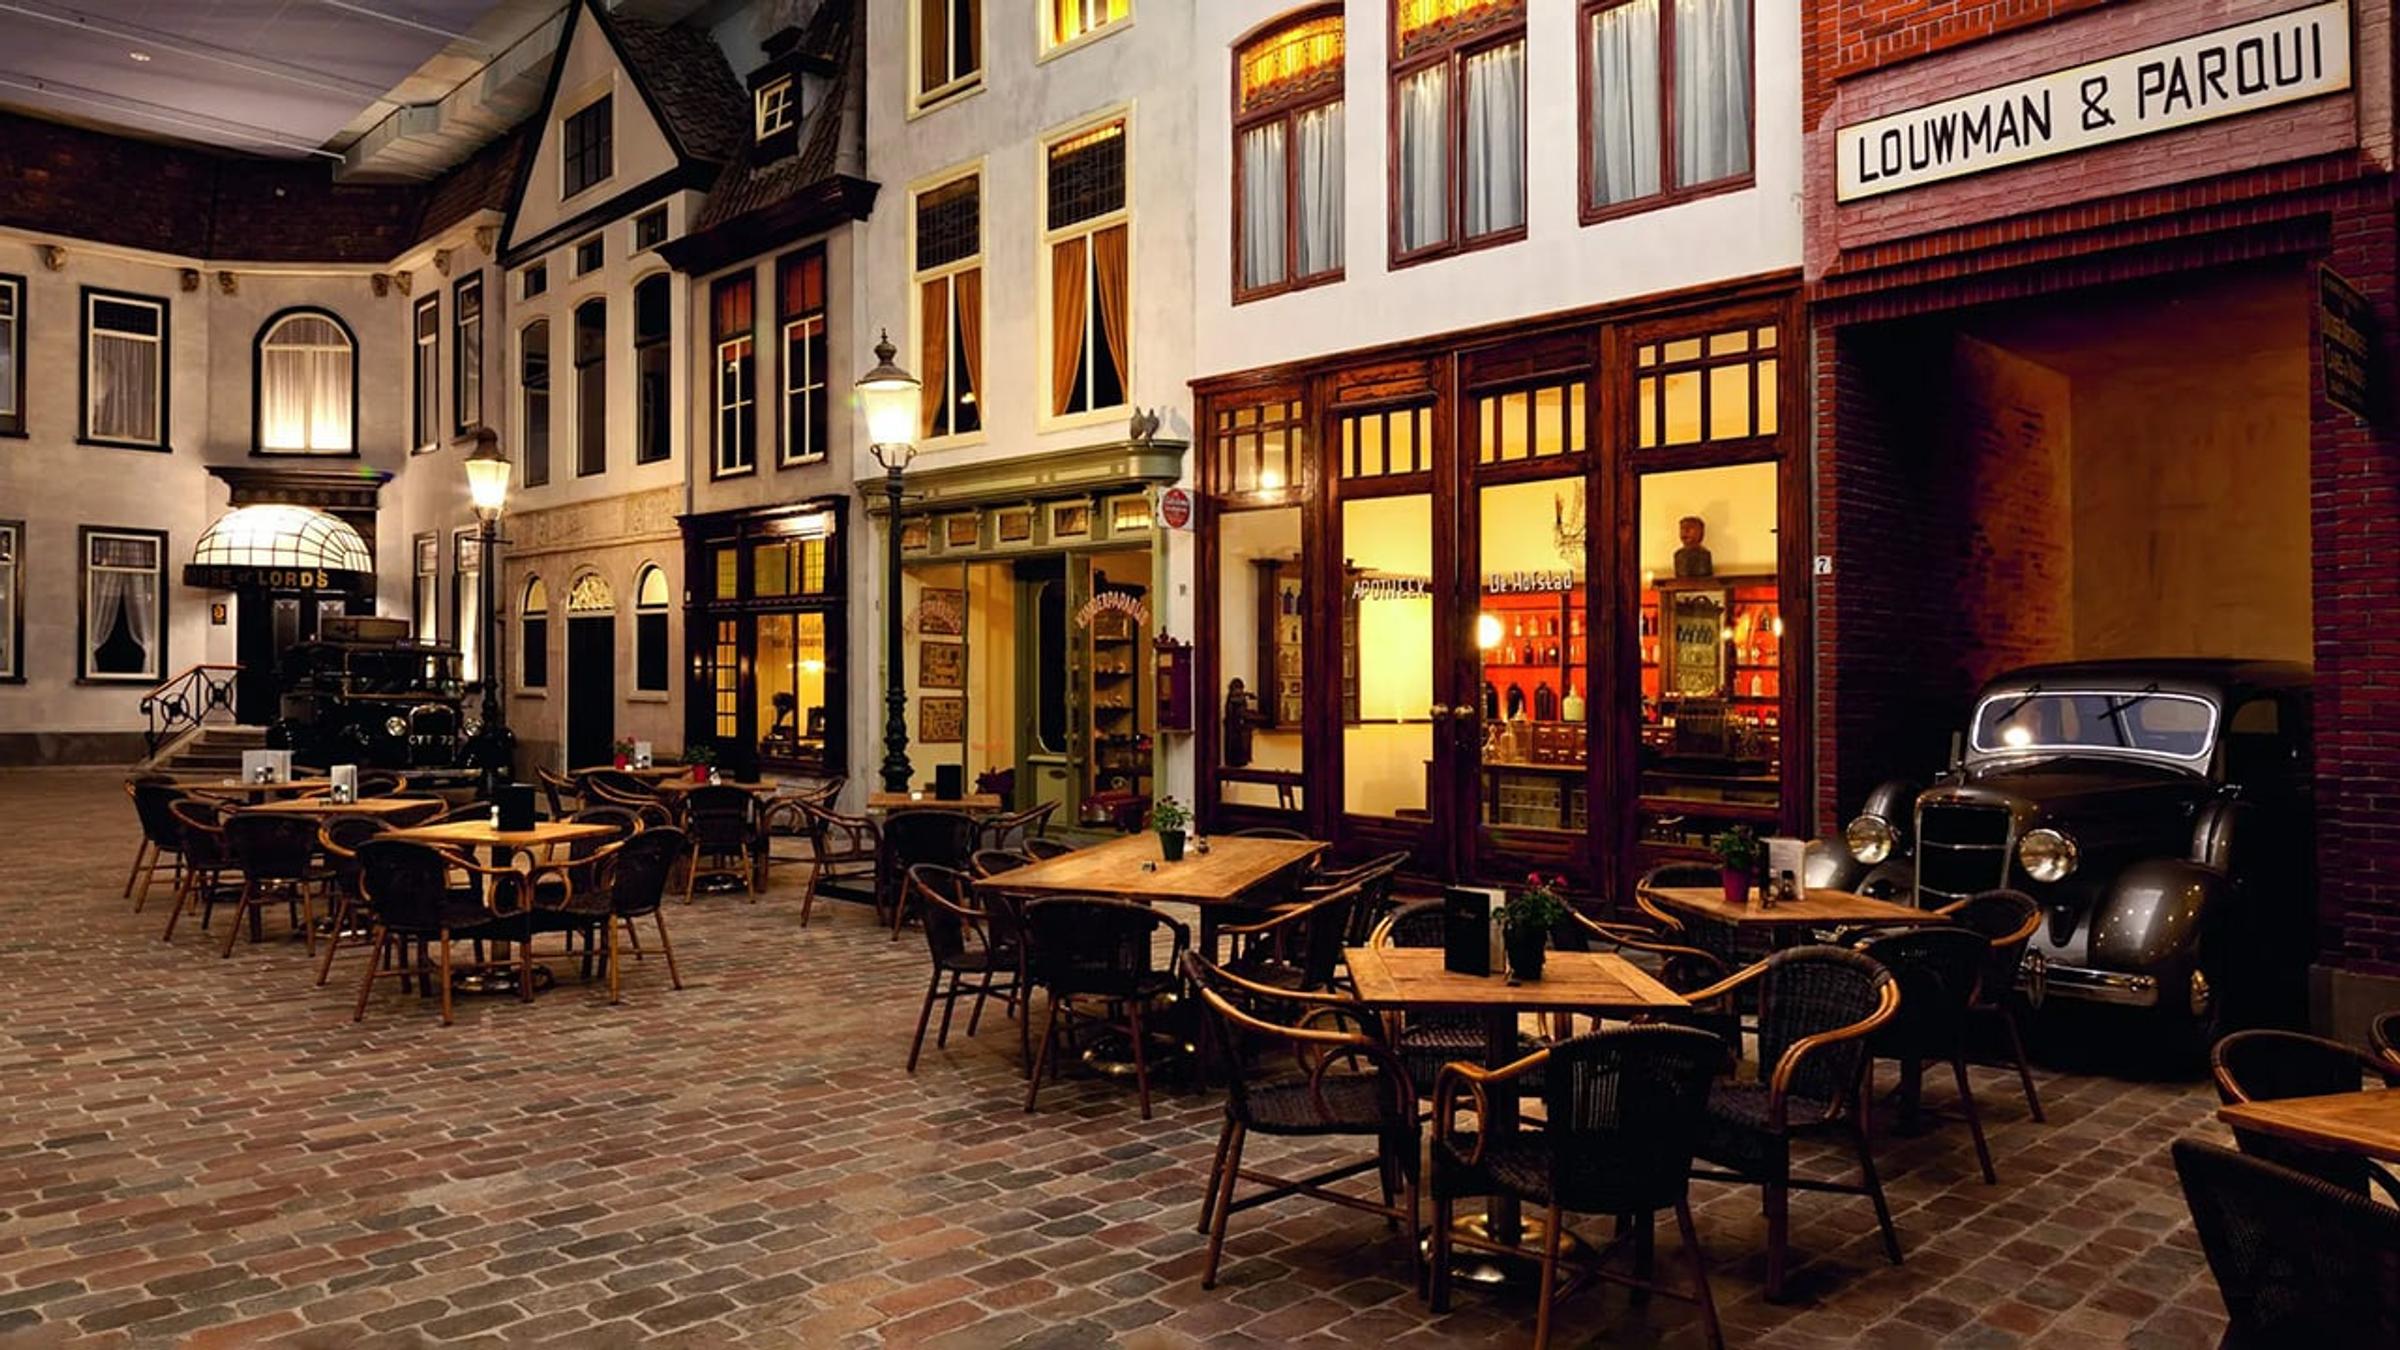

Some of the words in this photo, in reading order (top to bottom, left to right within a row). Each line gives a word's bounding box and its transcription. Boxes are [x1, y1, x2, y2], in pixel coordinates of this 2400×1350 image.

[1859, 90, 2052, 184] LOUWMAN
[2081, 75, 2116, 131] &
[2137, 22, 2323, 120] PARQUI
[1818, 558, 1827, 573] 7
[258, 570, 328, 588] LORDS
[1351, 577, 1427, 600] APOTHEEK
[1489, 572, 1507, 594] De
[1513, 570, 1574, 592] Hofstad
